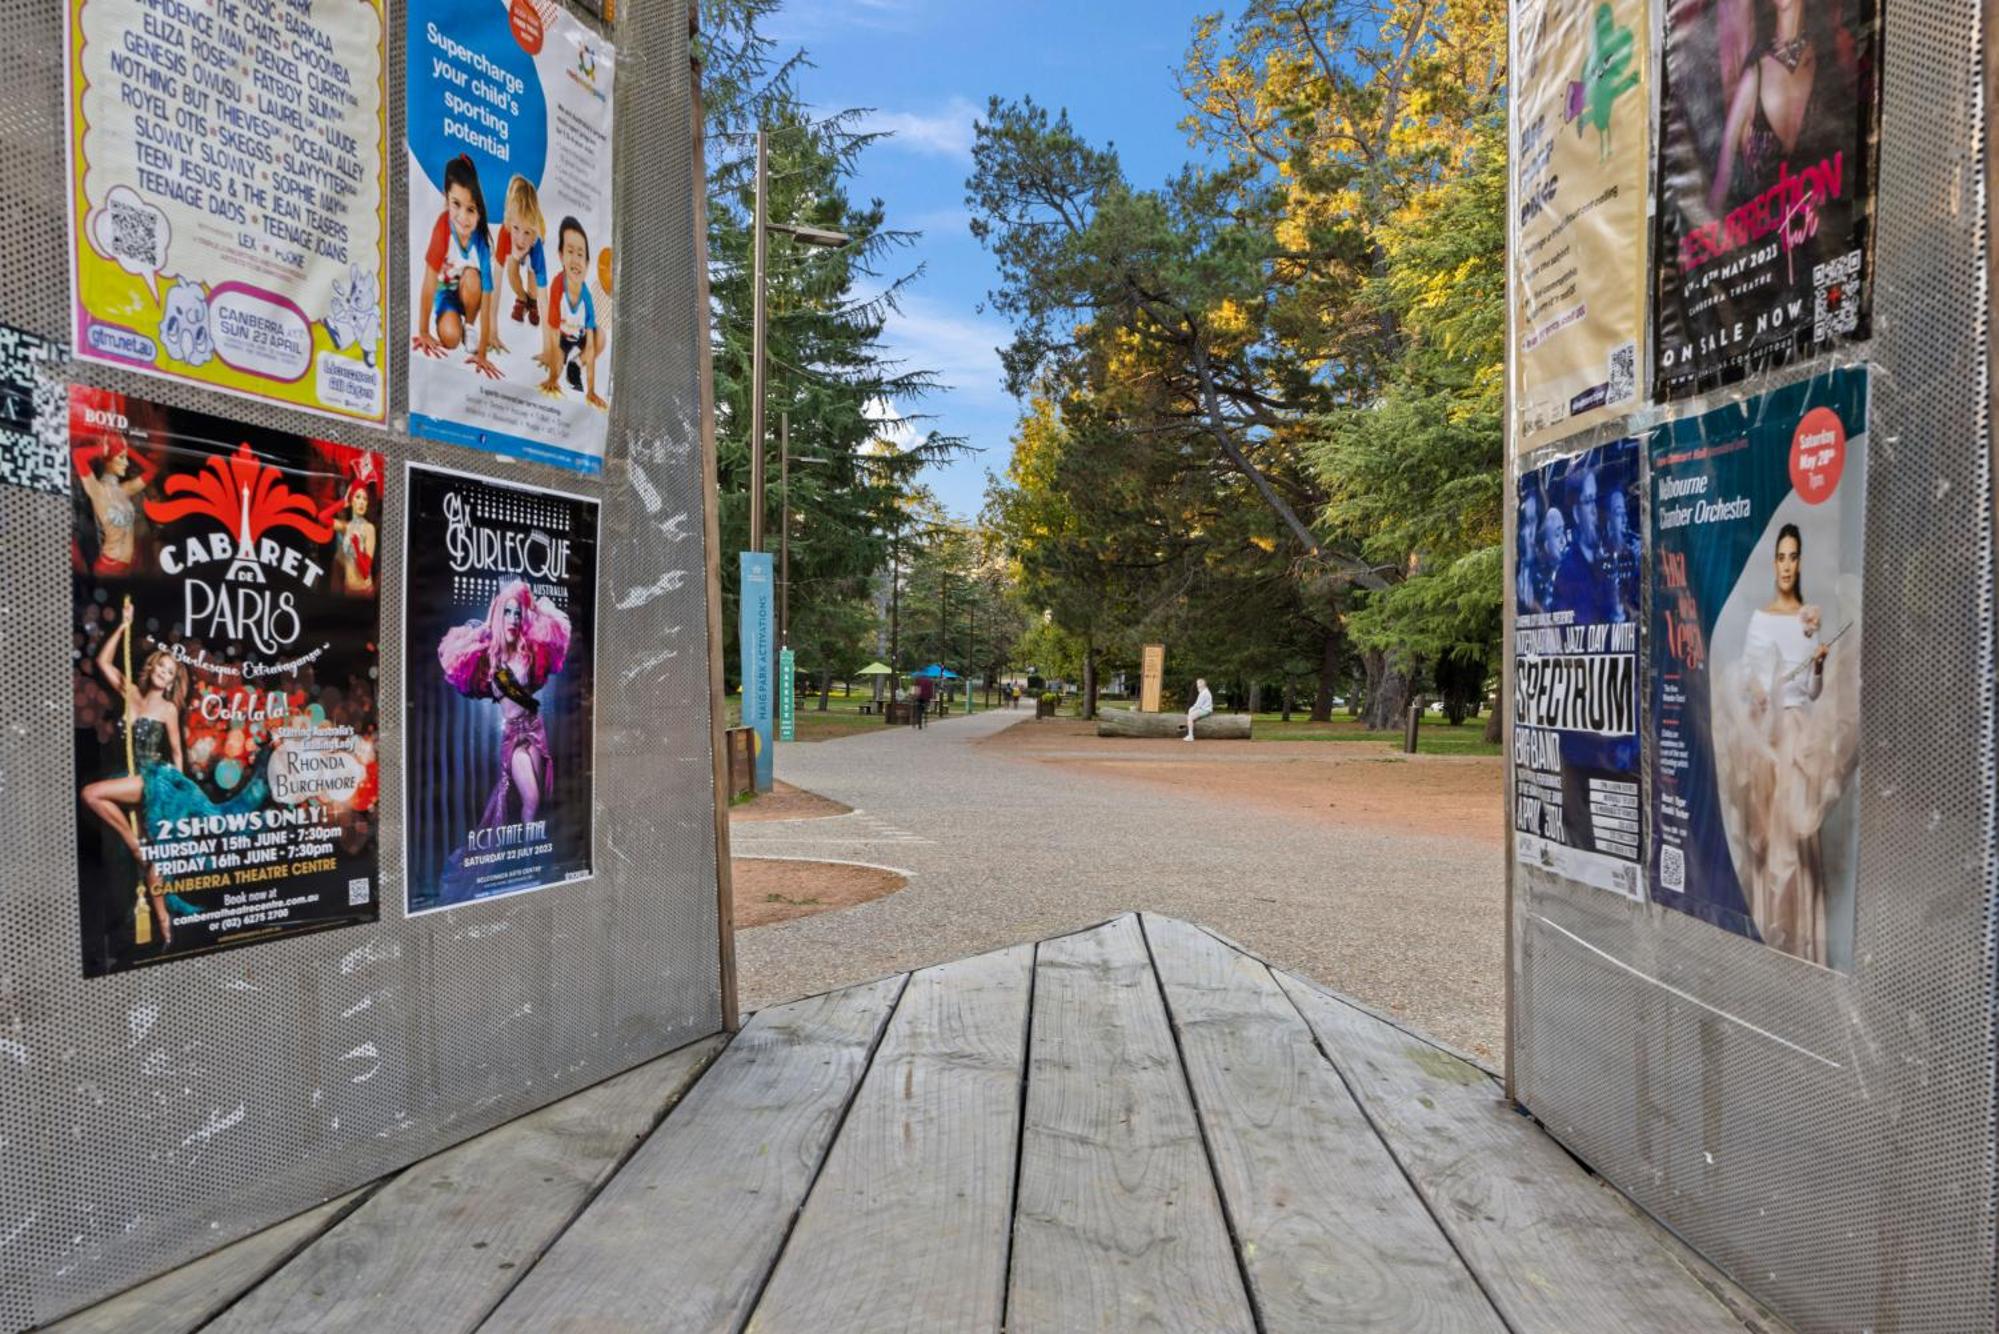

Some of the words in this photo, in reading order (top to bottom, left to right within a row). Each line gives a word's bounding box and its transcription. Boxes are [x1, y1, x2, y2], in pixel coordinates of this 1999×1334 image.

[243, 13, 281, 50] CHATS
[124, 30, 187, 77] GENESIS
[193, 63, 241, 102] OWUSU
[144, 12, 185, 50] ELIZA
[254, 68, 303, 106] FATBOY
[255, 45, 302, 85] DENZEL
[427, 22, 524, 95] Supercharge
[432, 57, 468, 88] your
[472, 77, 519, 117] child's
[111, 50, 177, 99] NOTHING
[183, 84, 210, 113] BUT
[292, 134, 333, 168] OCEAN
[121, 82, 169, 121] ROYEL
[175, 107, 208, 138] OTIS
[219, 126, 273, 165] SKEGSS
[444, 91, 509, 140] sporting
[444, 118, 510, 162] potential
[135, 115, 194, 156] SLOWLY
[201, 142, 255, 180] SLOWLY
[272, 172, 316, 206] SOPHIE
[135, 141, 172, 170] TEEN
[180, 158, 221, 192] JESUS
[228, 178, 237, 198] &
[242, 182, 267, 210] THE
[272, 195, 301, 222] JEAN
[137, 167, 203, 209] TEENAGE
[209, 194, 246, 225] DADS
[262, 214, 313, 251] TEENAGE
[1721, 259, 1747, 281] MAY
[218, 306, 285, 335] CANBERRA
[220, 320, 250, 340] SUN
[253, 330, 268, 345] 23
[270, 337, 302, 355] APRIL
[1662, 343, 1694, 367] ON
[1700, 322, 1744, 355] SALE
[1756, 299, 1803, 334] NOW
[84, 409, 129, 430] BOYD
[1799, 429, 1836, 450] Saturday
[1694, 495, 1751, 524] Orchestra
[185, 579, 300, 655] PARIS
[759, 595, 767, 663] ACTIVATIONS
[1587, 624, 1609, 652] DAY
[759, 666, 767, 693] PARK
[1517, 657, 1633, 732] SPECTRUM
[759, 695, 767, 721] HAIG
[157, 820, 173, 841] 2
[176, 811, 262, 839] SHOWS
[266, 807, 328, 828] ONLY!
[468, 828, 493, 851] ACT
[139, 839, 217, 861] THURSDAY
[222, 835, 251, 852] 15th
[254, 831, 287, 847] JUNE
[297, 826, 342, 842] 7:30pm
[154, 855, 206, 878] FRIDAY
[210, 852, 241, 869] 16th
[244, 848, 278, 864] JUNE
[288, 842, 334, 859] 7:30pm
[464, 851, 505, 868] SATURDAY
[150, 875, 230, 896] CANBERRA
[234, 865, 289, 884] THEATRE
[291, 858, 337, 876] CENTRE
[223, 891, 247, 906] Book
